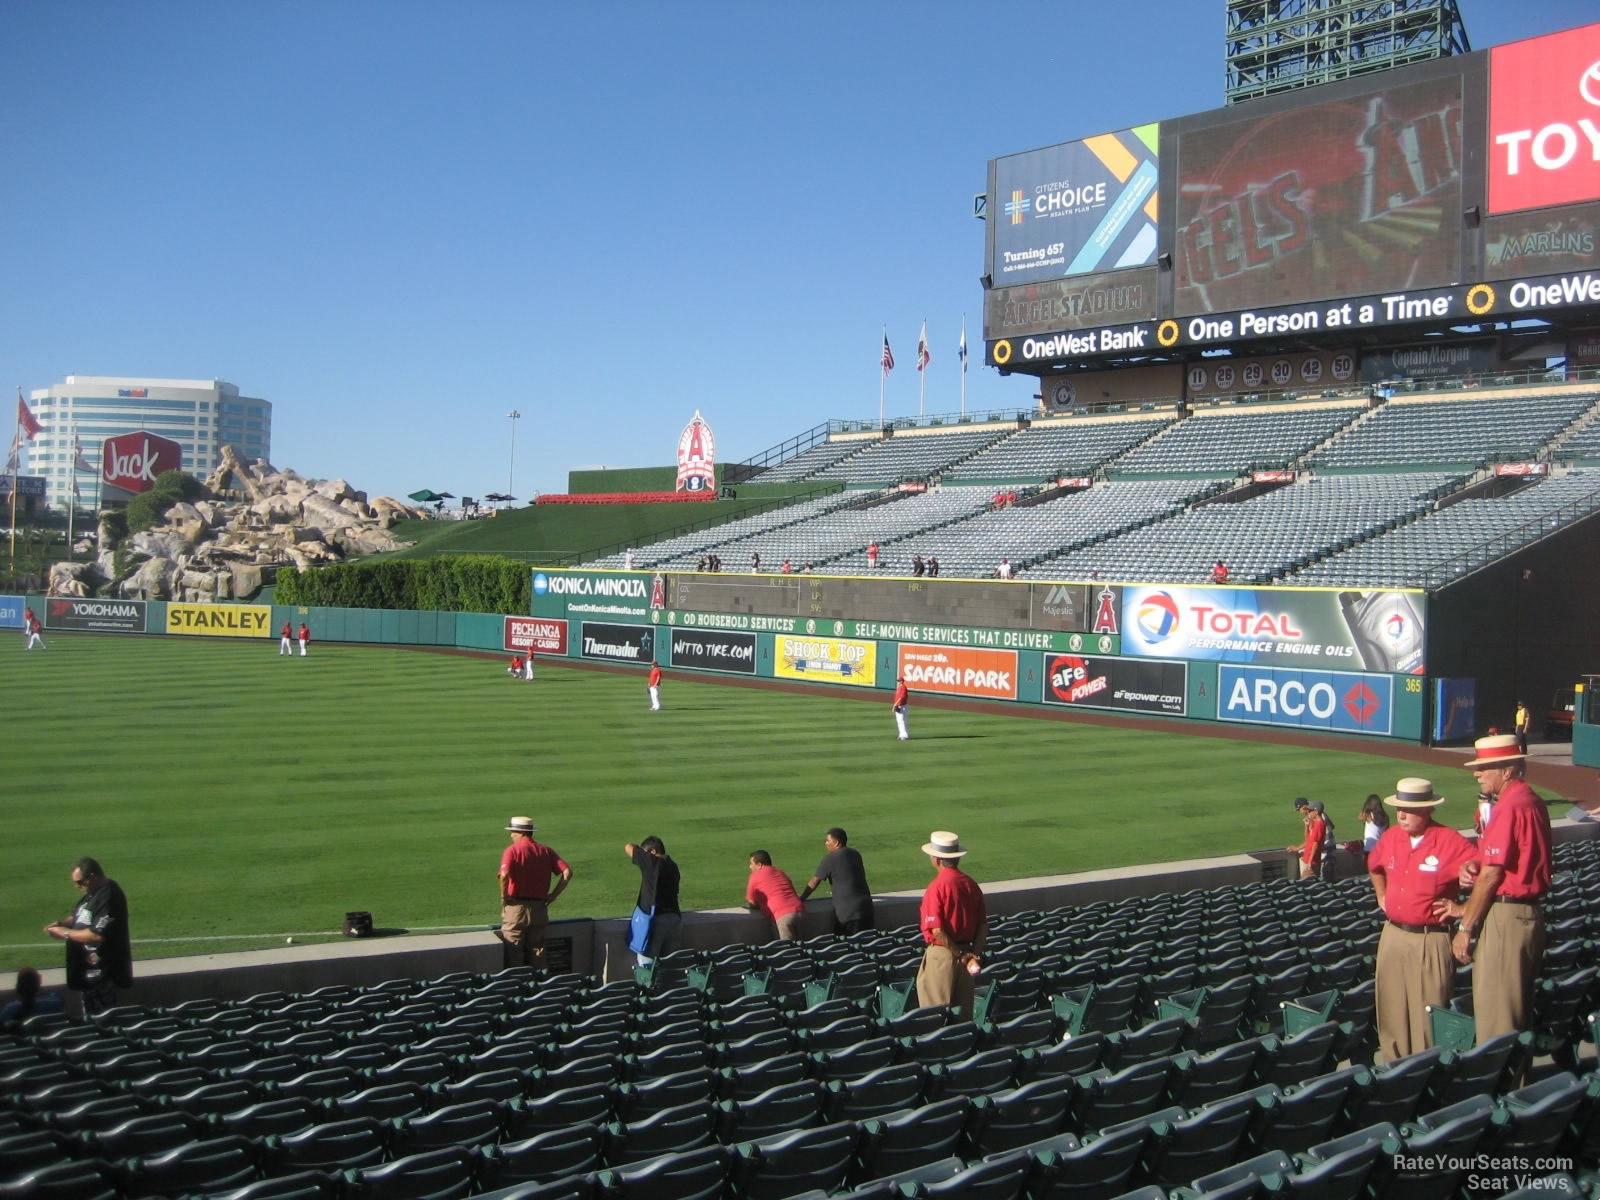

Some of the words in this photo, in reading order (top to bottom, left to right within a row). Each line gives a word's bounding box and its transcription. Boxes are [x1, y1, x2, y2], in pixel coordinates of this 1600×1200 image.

[1035, 183, 1106, 212] CHOICE
[1036, 180, 1069, 194] CITIZENS
[1004, 247, 1046, 262] Turning
[1047, 243, 1064, 255] 65?
[1501, 231, 1594, 264] MARLINS
[1061, 285, 1143, 317] STADIUM
[1022, 332, 1096, 360] OneWest
[1101, 326, 1144, 351] Bank
[1189, 318, 1233, 341] One
[1240, 311, 1318, 336] Person
[1325, 304, 1352, 327] at
[1359, 305, 1374, 323] a
[1382, 296, 1449, 320] Time
[1274, 363, 1289, 377] 30
[1303, 361, 1319, 375] 42
[1335, 359, 1350, 372] 50
[105, 439, 160, 481] Jack
[548, 576, 593, 596] KONICA
[594, 578, 647, 598] MINOLTA
[73, 603, 138, 617] YOKOHAMA
[170, 609, 268, 629] STANLEY
[568, 603, 646, 616] CountOnKonicaMinolta.com
[1043, 606, 1073, 616] Majestic
[511, 622, 560, 638] PECHANGA
[684, 613, 696, 625] OD
[698, 614, 748, 628] HOUSEHOLD
[751, 617, 794, 631] SERVICES
[1190, 606, 1300, 637] TOTAL
[512, 637, 534, 646] RESORT
[537, 639, 560, 649] CASINO
[855, 623, 919, 640] SELF-MOVING
[922, 627, 969, 643] SERVICES
[973, 630, 999, 645] THAT
[584, 637, 640, 658] Thermador
[673, 639, 704, 656] NITTO
[705, 644, 753, 662] TIRE.COM
[784, 639, 829, 659] SHOCK
[837, 643, 865, 661] TOP
[1188, 639, 1272, 653] PERFORMANCE
[1276, 642, 1321, 655] ENGINE
[1325, 645, 1353, 657] OILS
[903, 663, 961, 685] SAFARI
[964, 668, 1011, 691] PARK
[1052, 666, 1085, 687] aFe
[1405, 678, 1421, 692] 365
[1071, 676, 1107, 701] POWER
[1227, 677, 1336, 719] ARCO
